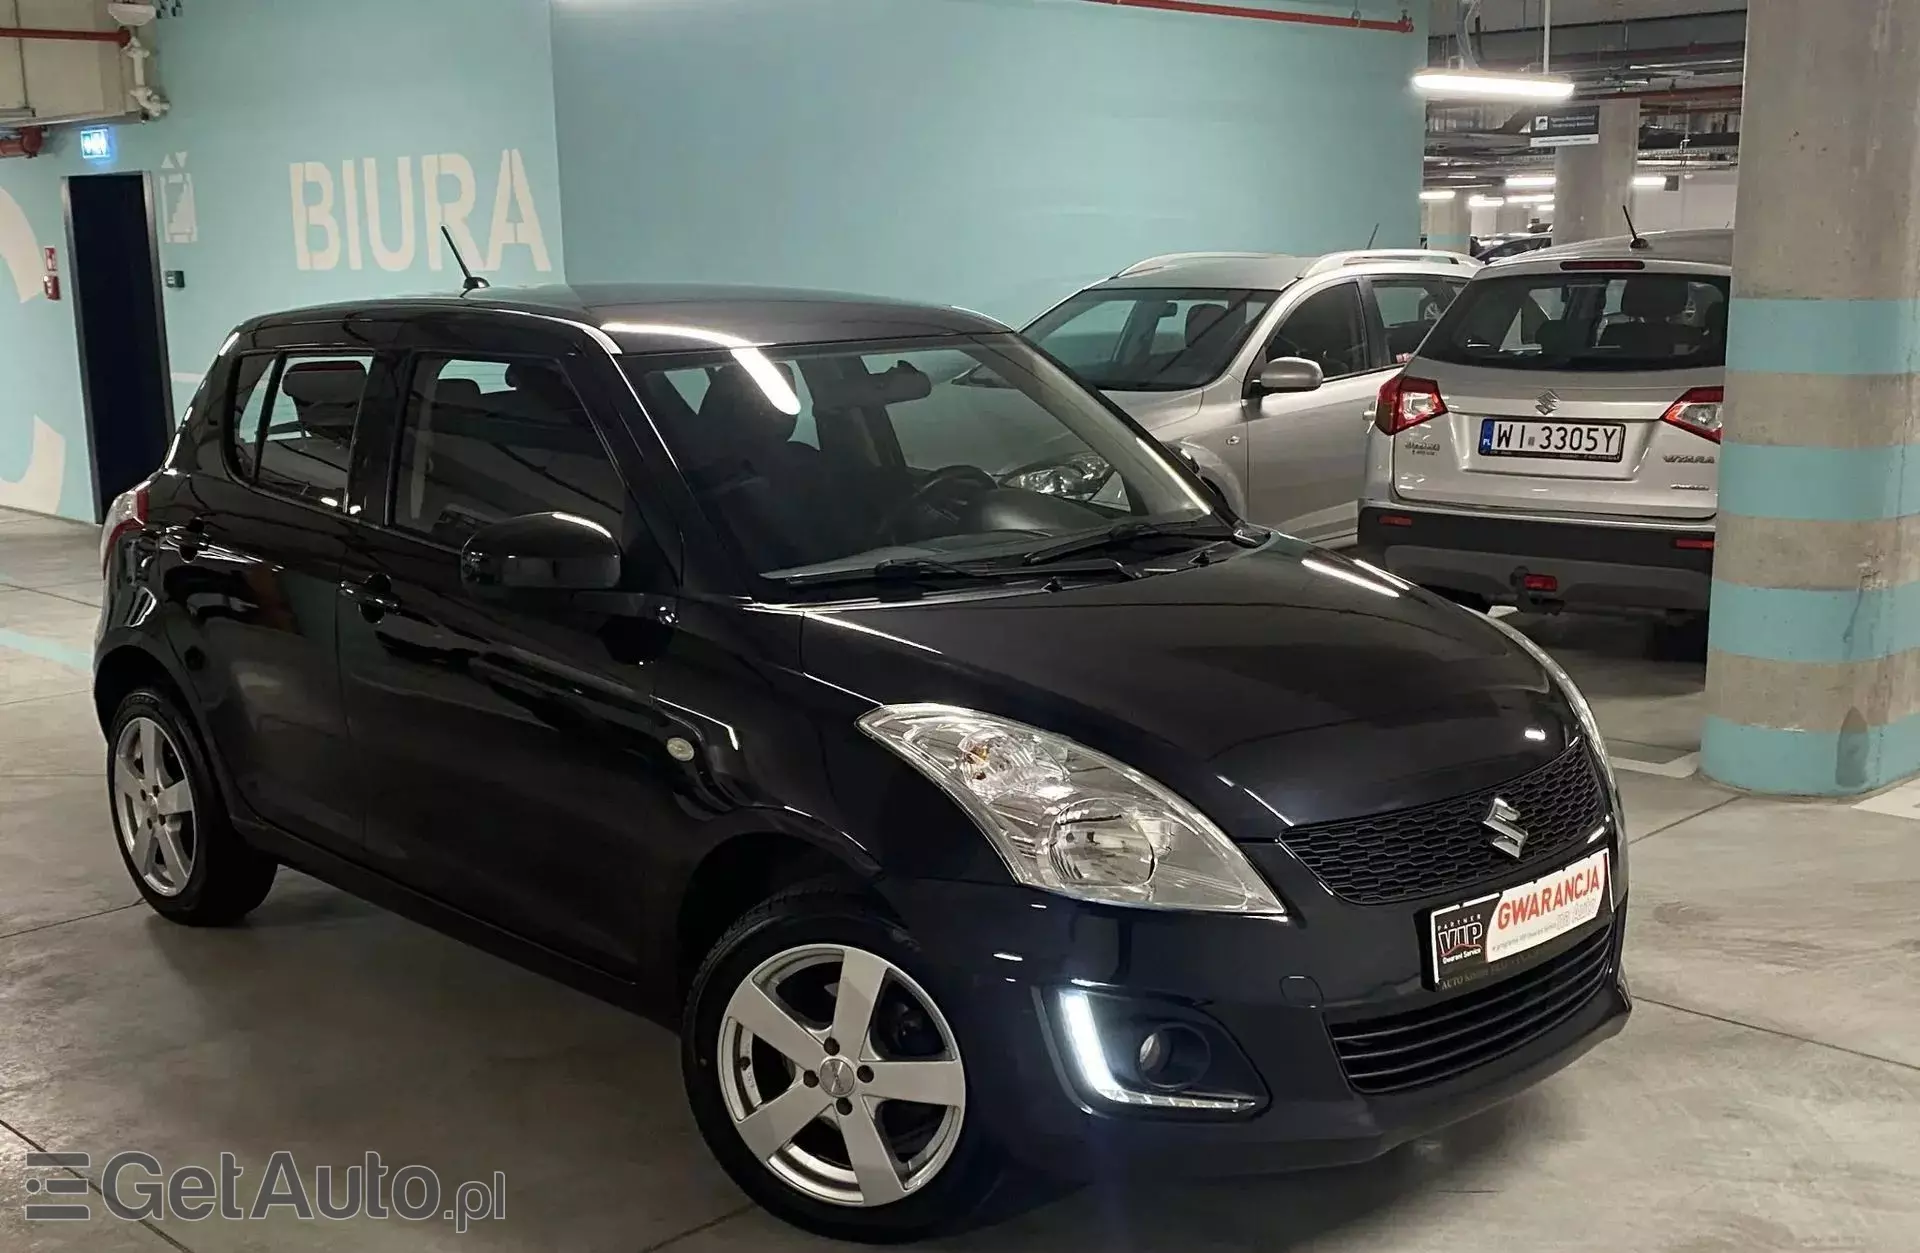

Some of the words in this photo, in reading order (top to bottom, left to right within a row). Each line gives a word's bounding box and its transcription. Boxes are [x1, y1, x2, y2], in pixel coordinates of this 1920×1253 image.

[289, 149, 552, 271] BIURA
[1497, 424, 1525, 448] WI
[1539, 426, 1618, 453] 3305Y
[1497, 865, 1600, 930] GWARANCJA
[1438, 922, 1483, 956] VIP
